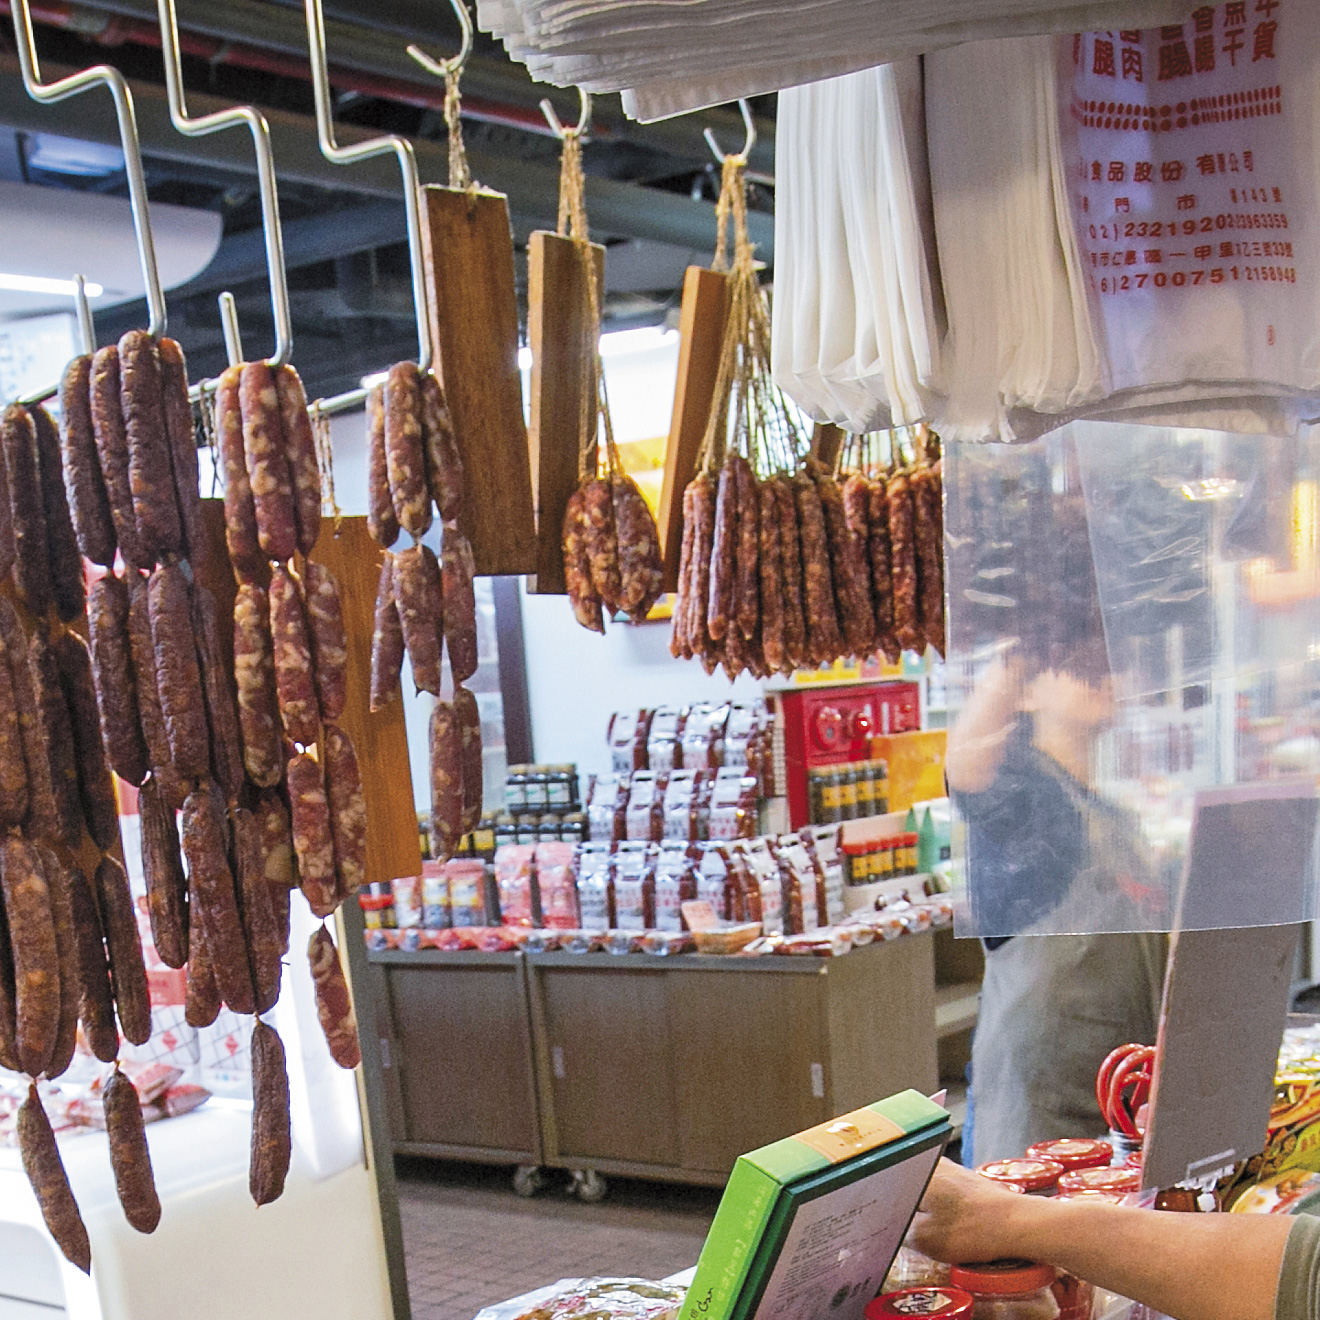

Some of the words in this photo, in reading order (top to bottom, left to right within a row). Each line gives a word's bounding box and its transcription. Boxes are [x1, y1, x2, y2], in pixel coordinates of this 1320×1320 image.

[1080, 150, 1253, 183] 食品股份有限公司
[1091, 265, 1240, 295] 6)2700751
